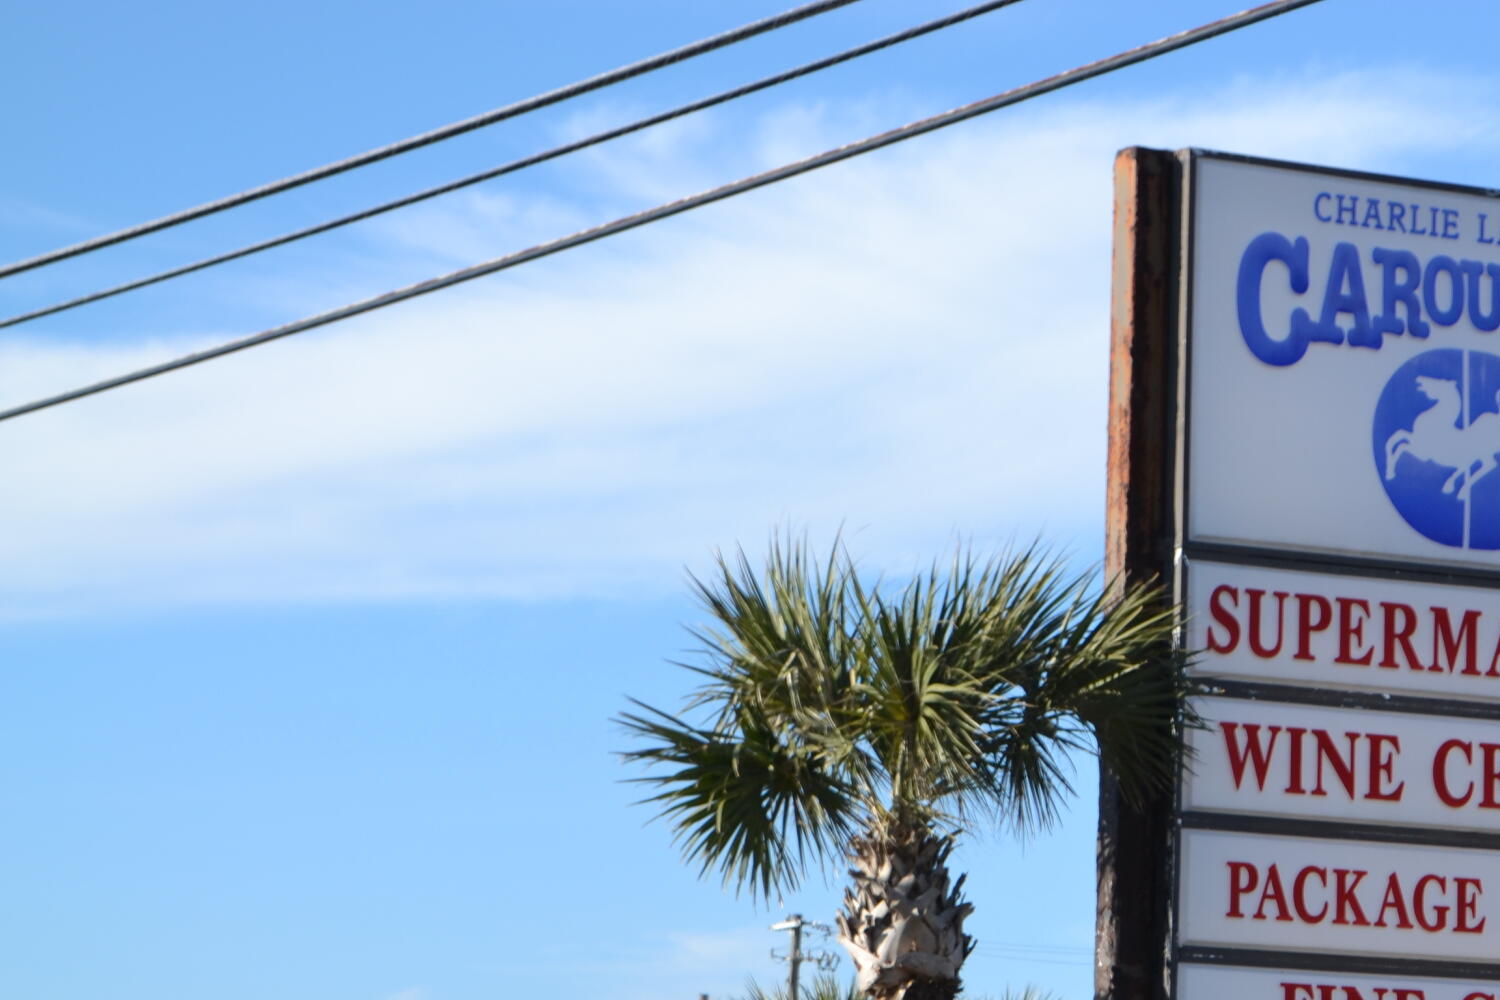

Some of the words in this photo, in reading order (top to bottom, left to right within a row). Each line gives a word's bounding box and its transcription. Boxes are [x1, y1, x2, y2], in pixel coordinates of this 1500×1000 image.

[1313, 191, 1461, 241] CHARLIE
[1219, 721, 1405, 803] WINE
[1226, 861, 1486, 935] PACKAGE
